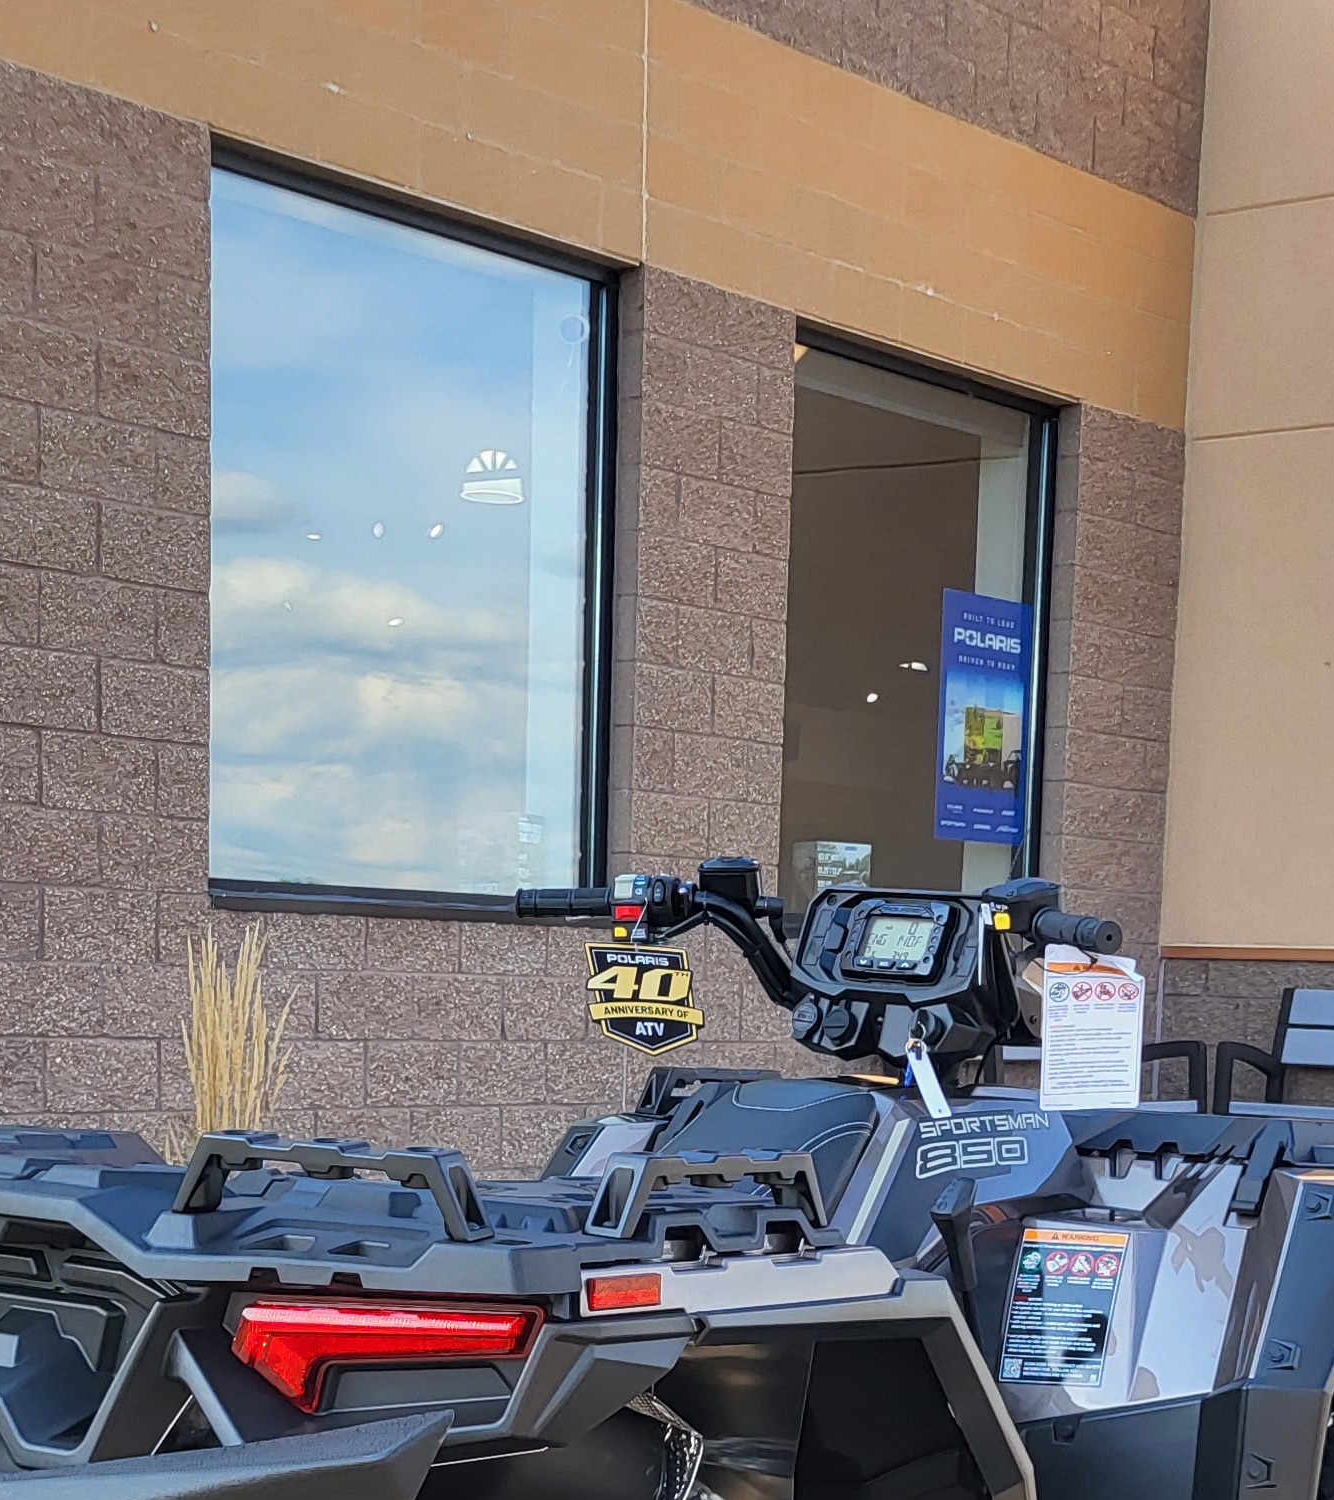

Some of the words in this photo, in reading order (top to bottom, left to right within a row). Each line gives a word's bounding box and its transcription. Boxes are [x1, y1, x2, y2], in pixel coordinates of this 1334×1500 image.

[953, 627, 1021, 654] POLARIS
[607, 954, 669, 966] POLARIS
[604, 1005, 674, 1016] ANNIVERSARY
[677, 1009, 689, 1018] OF
[635, 1022, 665, 1036] ATV
[918, 1112, 1050, 1138] SPORTSMAN
[916, 1136, 1029, 1179] 850
[1061, 1233, 1099, 1242] WARNING
